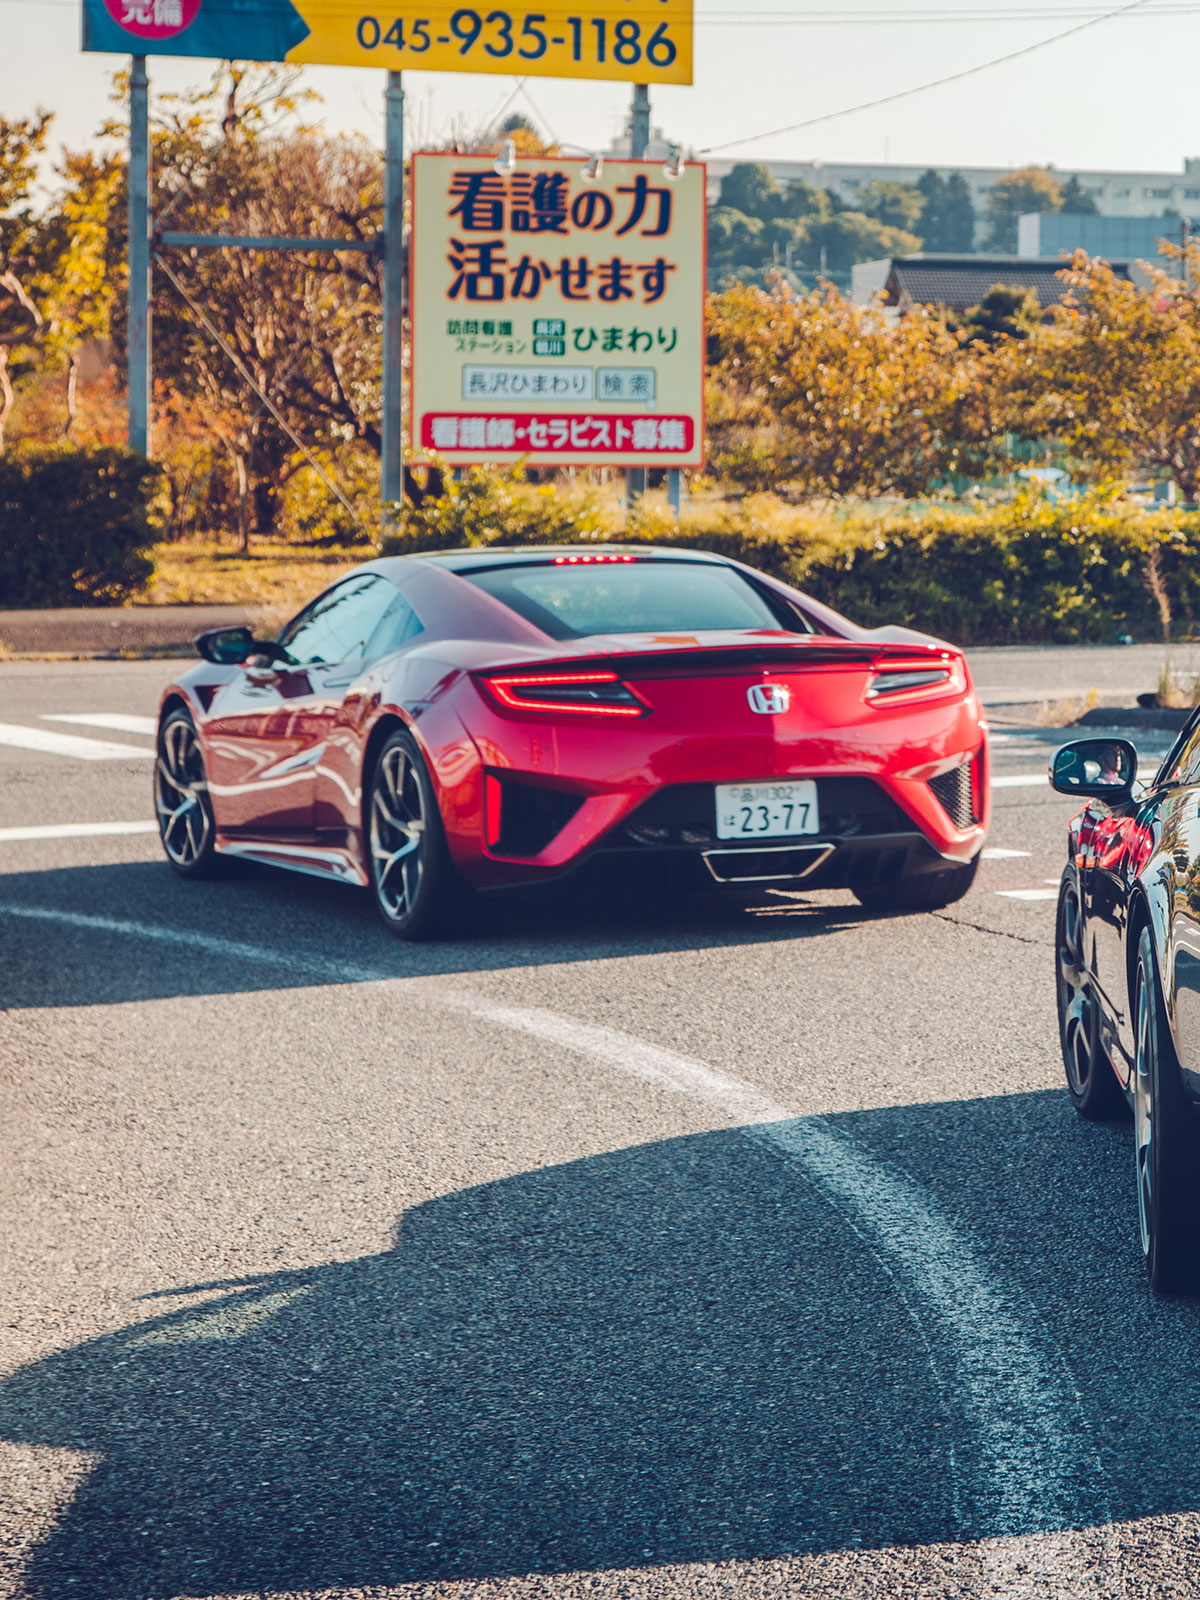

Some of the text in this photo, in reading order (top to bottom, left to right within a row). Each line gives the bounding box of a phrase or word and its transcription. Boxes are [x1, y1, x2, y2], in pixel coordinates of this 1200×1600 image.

[356, 9, 677, 67] 045-935-1186
[448, 171, 673, 238] 看護の力
[447, 238, 677, 303] 活かせます
[447, 319, 513, 336] 訪問看護
[572, 326, 678, 354] ひまわり
[454, 338, 527, 354] ステーション
[470, 371, 587, 394] 長沢ひまわり
[602, 373, 650, 394] 検索
[740, 803, 811, 832] 23-77
